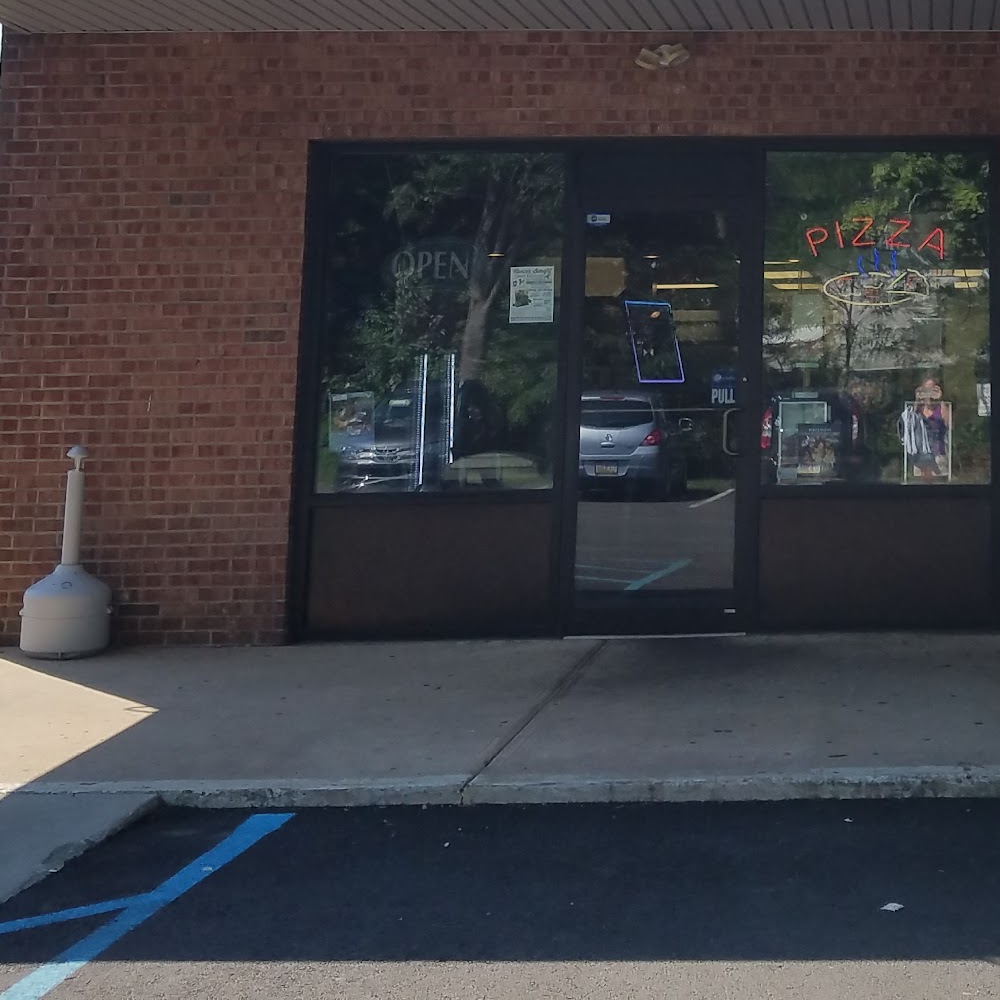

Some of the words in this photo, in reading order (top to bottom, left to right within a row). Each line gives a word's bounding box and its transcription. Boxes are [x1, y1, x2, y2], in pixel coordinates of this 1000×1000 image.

[805, 216, 945, 260] PIZZA
[392, 250, 469, 280] OPEN
[711, 388, 736, 404] PULL
